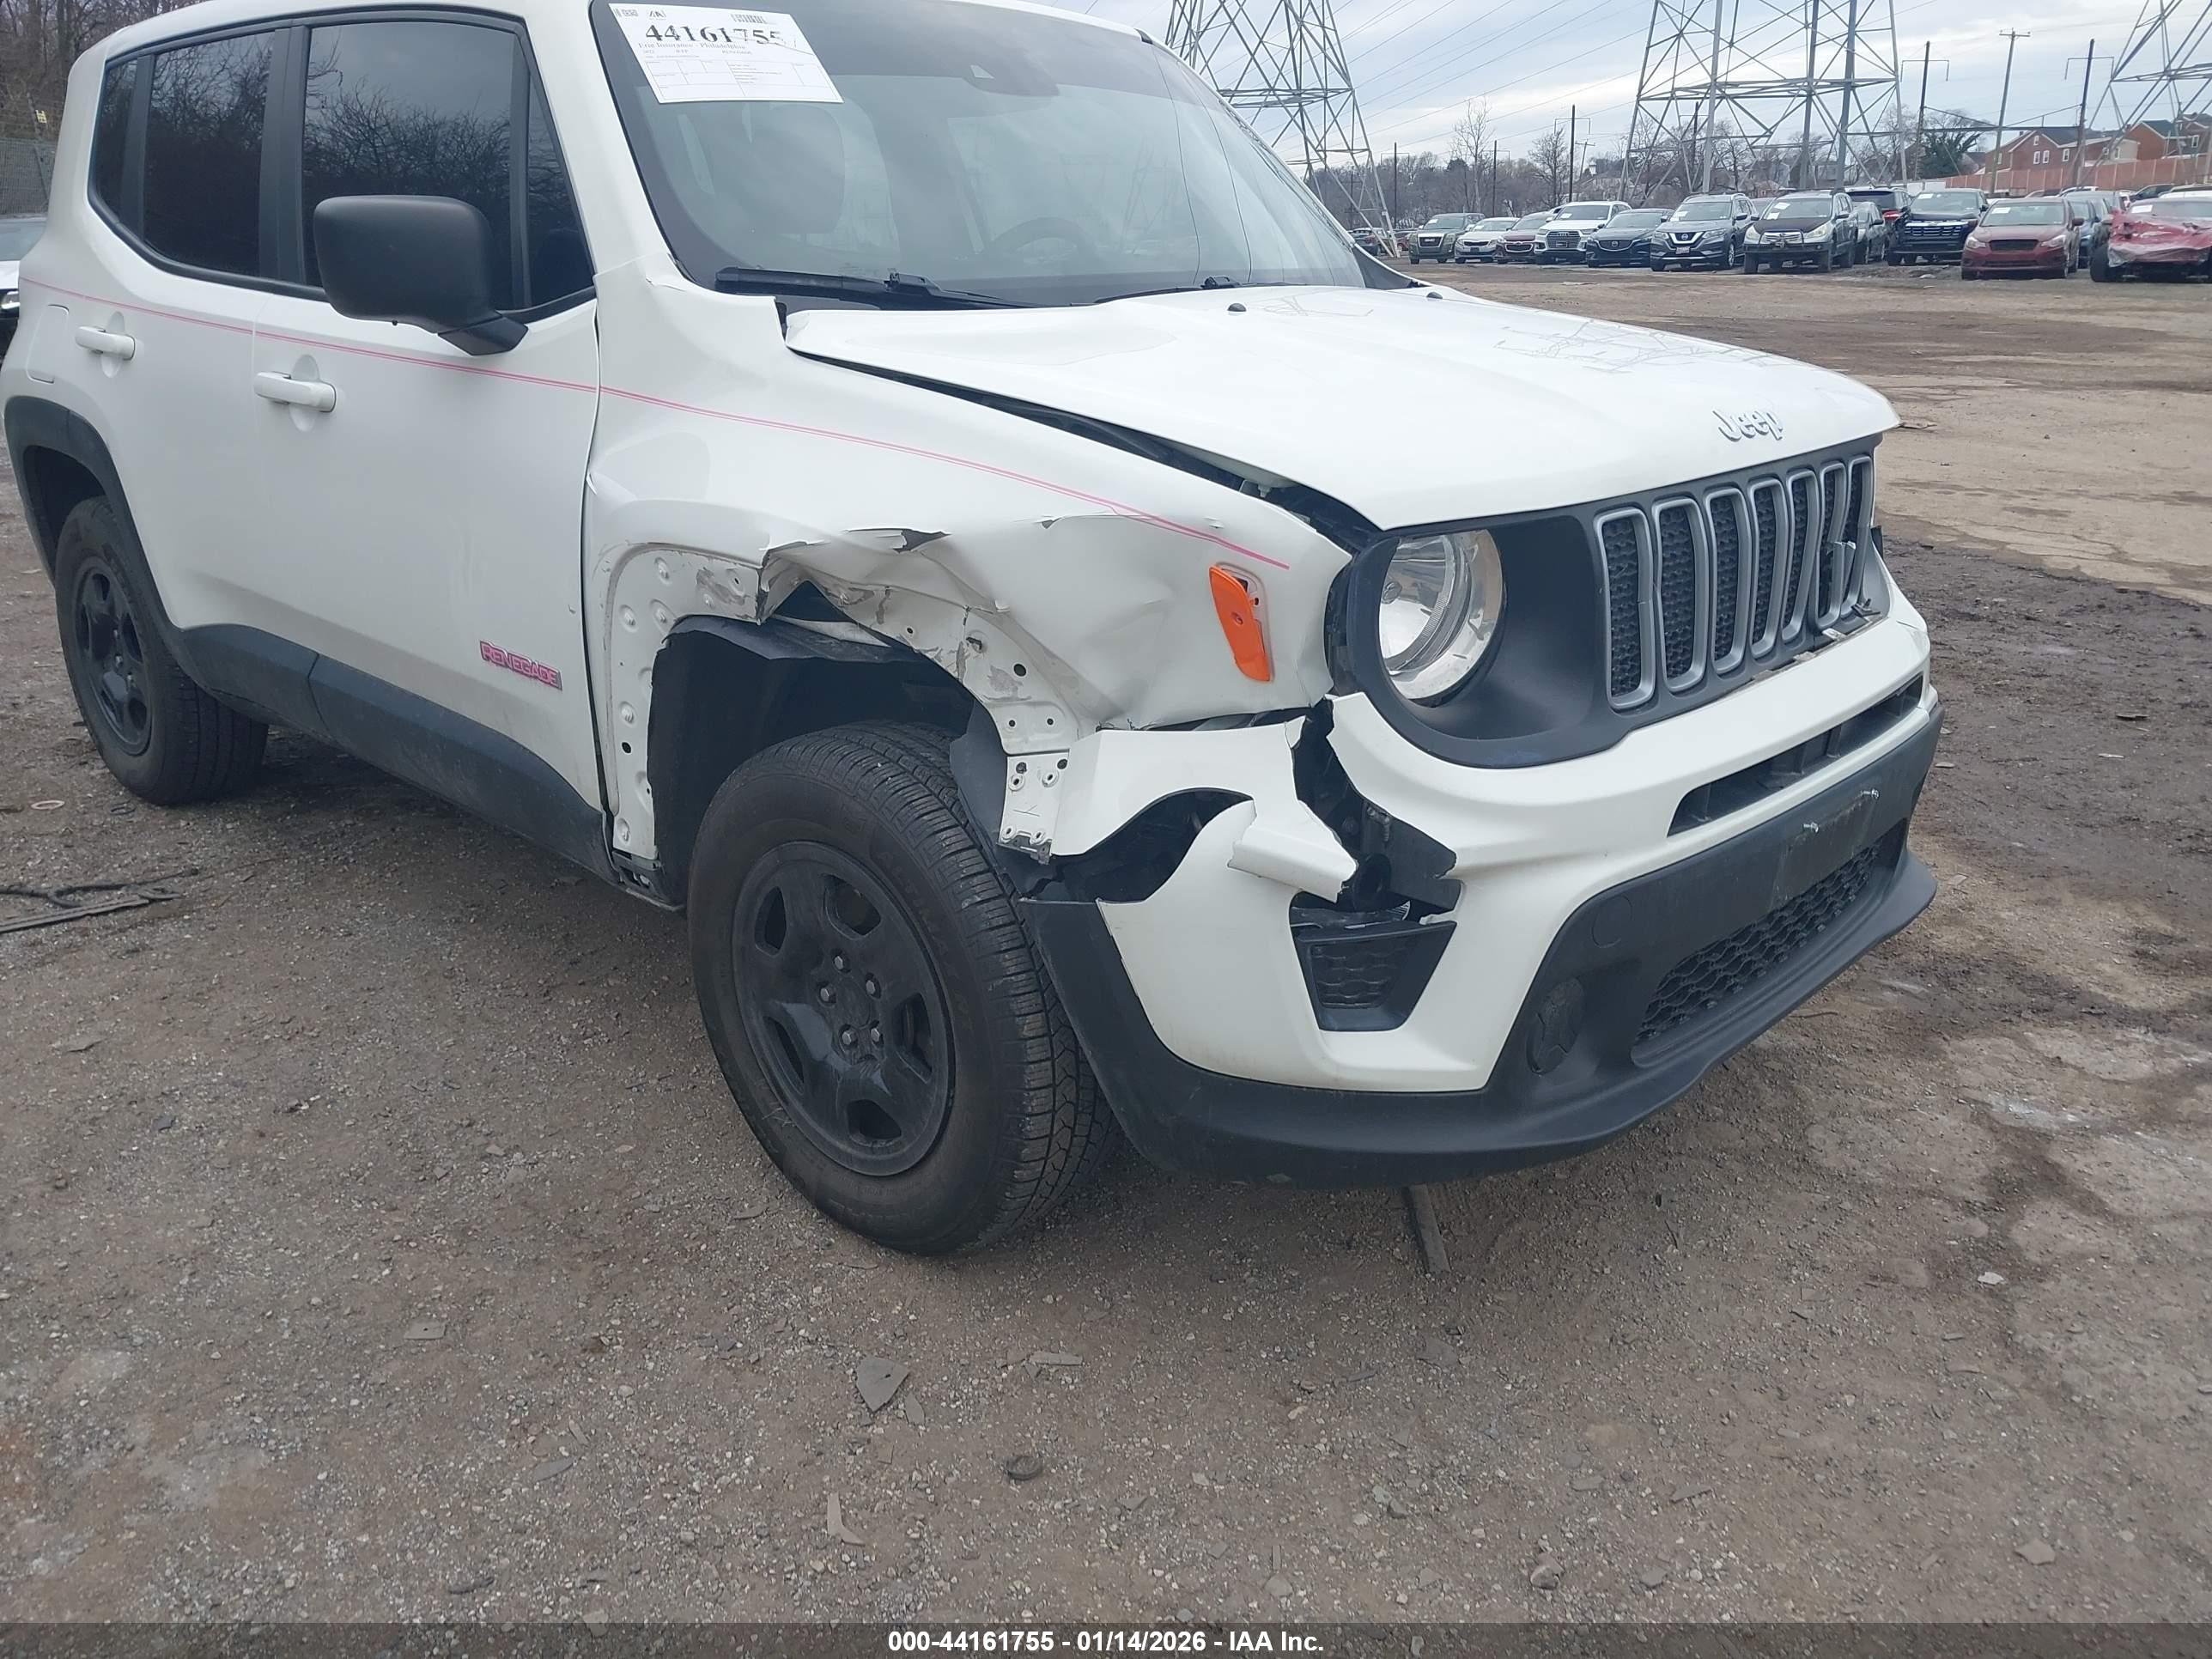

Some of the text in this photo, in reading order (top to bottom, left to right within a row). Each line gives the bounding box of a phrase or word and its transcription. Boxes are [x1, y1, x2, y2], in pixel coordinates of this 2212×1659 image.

[645, 24, 783, 44] 44161755
[1711, 410, 1784, 443] Jeep
[480, 641, 562, 690] RENEGADE
